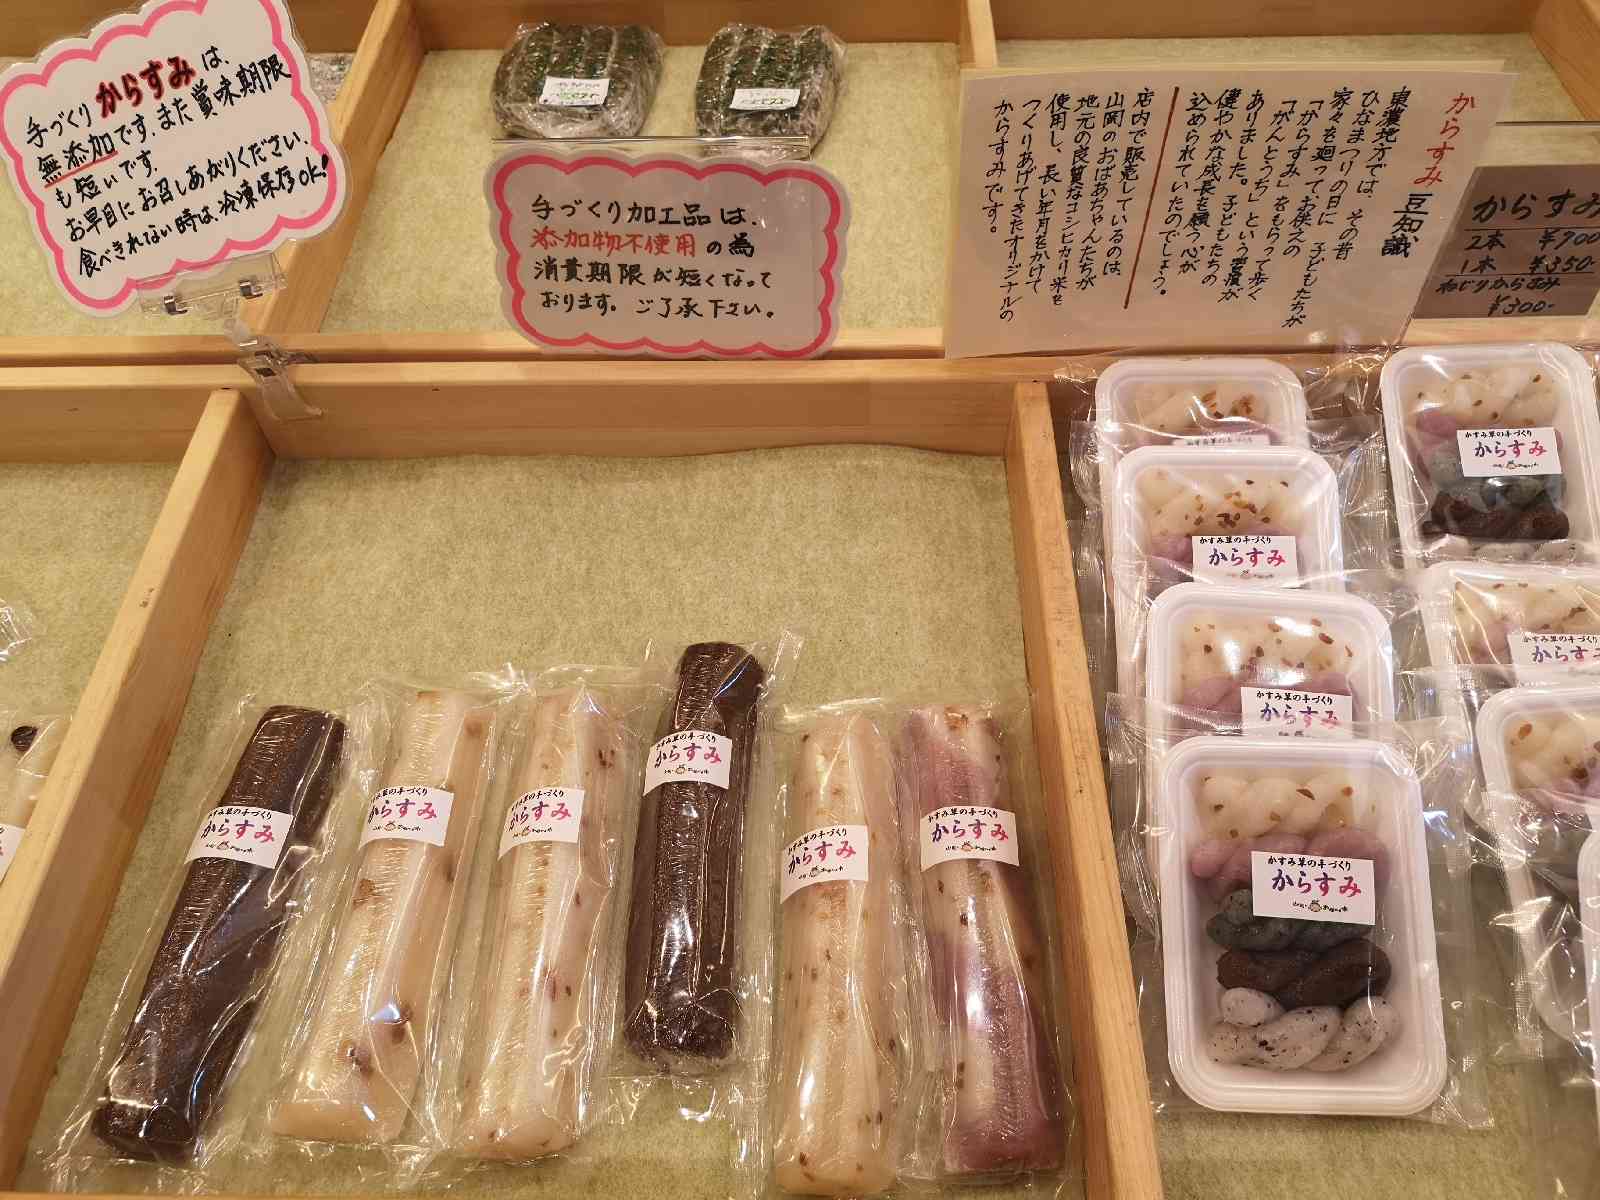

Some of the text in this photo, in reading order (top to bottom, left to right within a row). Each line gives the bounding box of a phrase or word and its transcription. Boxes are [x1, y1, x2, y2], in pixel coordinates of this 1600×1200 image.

[1474, 440, 1547, 458] からすみ
[1208, 547, 1286, 567] からすみ
[1260, 702, 1338, 729] からすみ
[654, 743, 721, 768] からすみ
[200, 818, 274, 843] からすみ
[931, 819, 1009, 843] からすみ
[788, 841, 856, 874] からすみ
[1268, 855, 1351, 871] かすみ草の手づくり
[1271, 869, 1361, 898] からすみ
